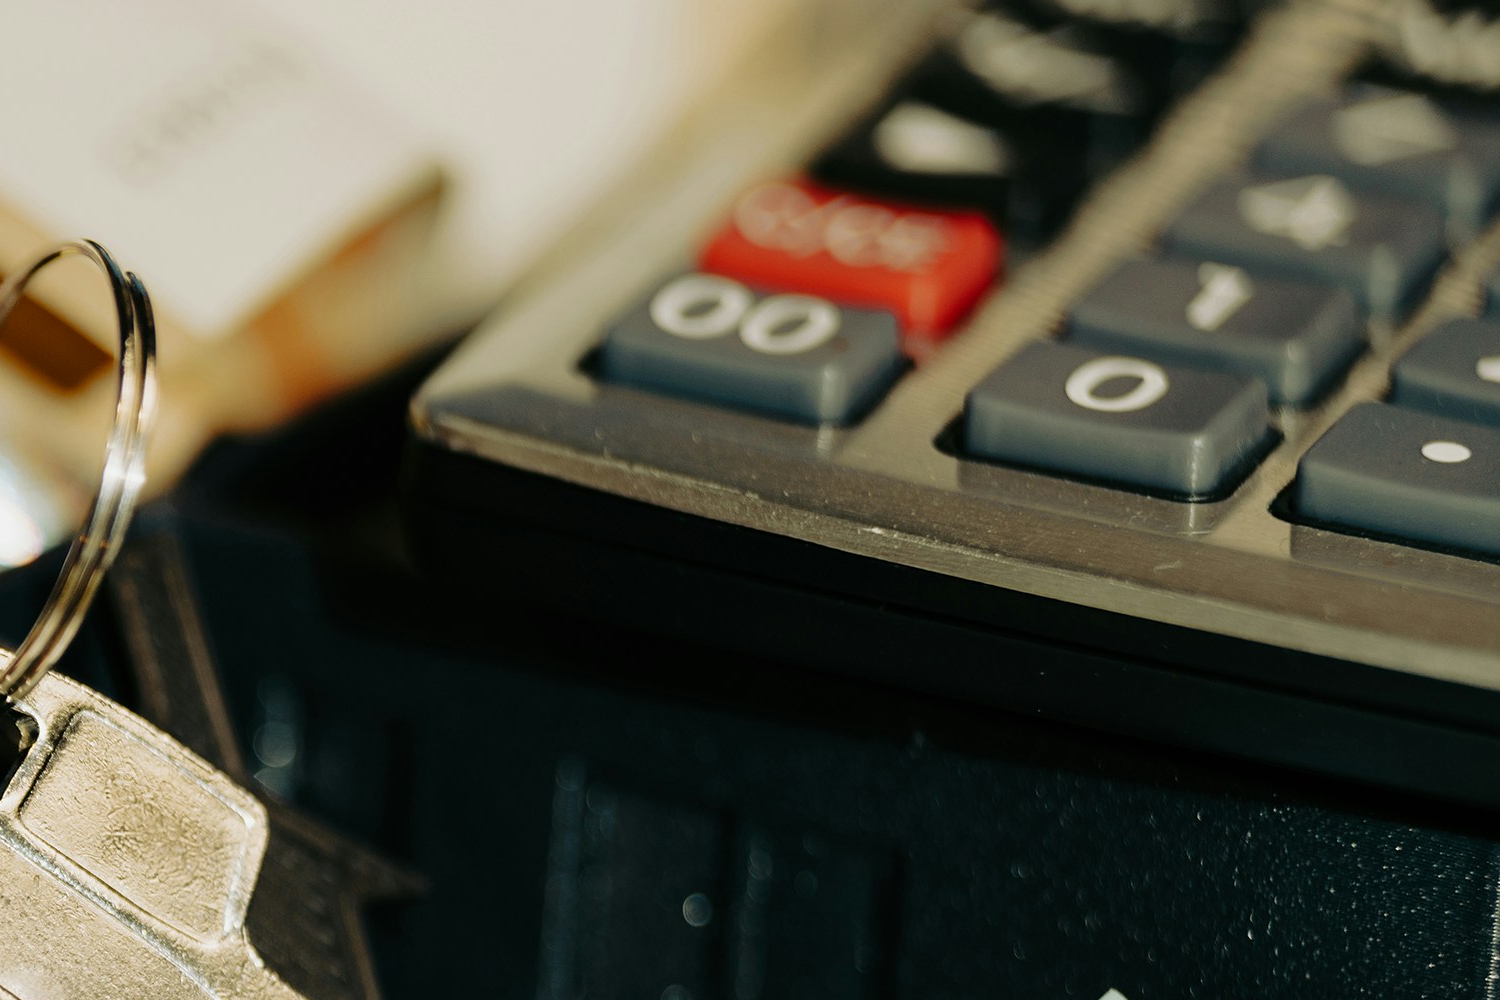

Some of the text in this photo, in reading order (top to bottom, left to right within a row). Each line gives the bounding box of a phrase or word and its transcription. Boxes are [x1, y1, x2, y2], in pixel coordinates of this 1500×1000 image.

[649, 273, 841, 355] 00
[1187, 263, 1252, 331] 1
[1065, 357, 1170, 412] 0
